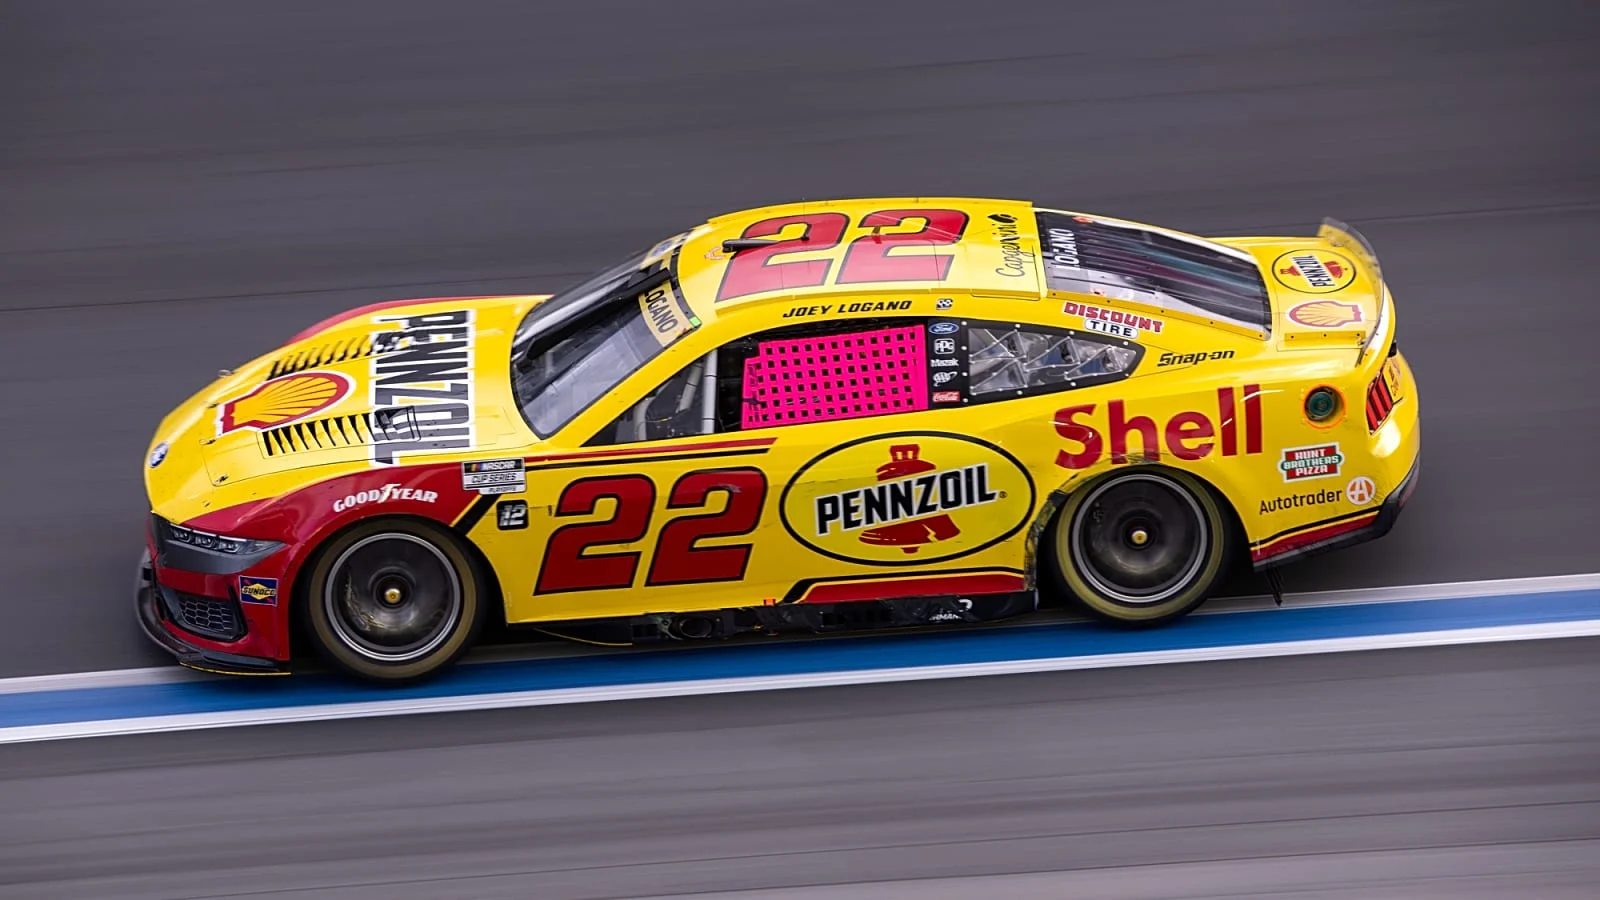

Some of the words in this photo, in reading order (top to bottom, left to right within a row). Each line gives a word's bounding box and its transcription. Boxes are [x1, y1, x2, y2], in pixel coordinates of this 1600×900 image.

[714, 208, 970, 304] 22
[992, 223, 1035, 277] Capgemini
[1048, 228, 1081, 270] LOGANO
[1290, 254, 1337, 288] PENNZOIL
[782, 304, 833, 318] JOEY
[837, 300, 912, 314] LOGANO
[1063, 302, 1163, 333] DISCOUNT
[1089, 320, 1132, 337] TIRE
[1157, 350, 1235, 367] Snap-on
[371, 309, 472, 465] PENNZOIL
[1054, 384, 1263, 470] Shell
[1283, 455, 1340, 470] BROTHERS
[1294, 448, 1327, 460] HUNT
[471, 474, 489, 484] CUP
[488, 472, 517, 483] SERIES
[1295, 465, 1329, 477] PIZZA
[333, 483, 439, 513] GOODYEAR
[815, 463, 999, 537] PENNZOIL
[1259, 488, 1343, 515] Autotrader
[499, 504, 527, 526] 12
[533, 466, 768, 596] 22
[242, 585, 277, 597] SUNOCO
